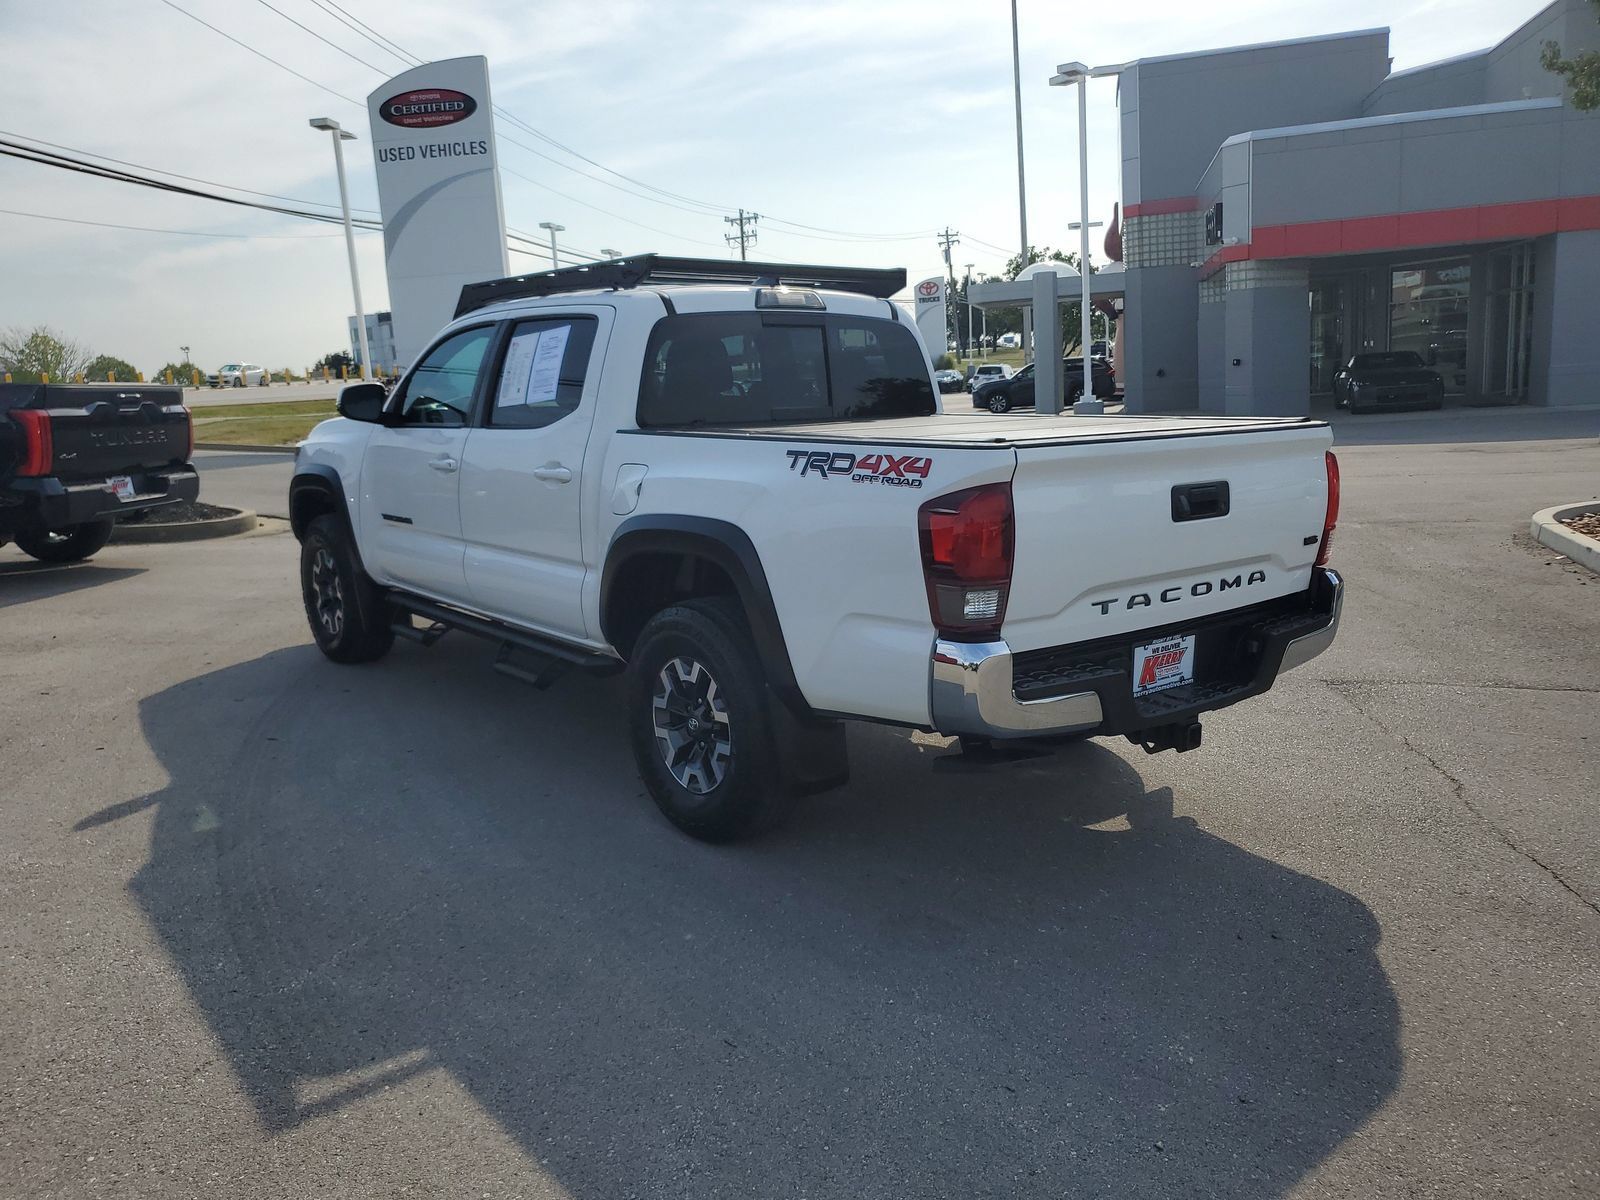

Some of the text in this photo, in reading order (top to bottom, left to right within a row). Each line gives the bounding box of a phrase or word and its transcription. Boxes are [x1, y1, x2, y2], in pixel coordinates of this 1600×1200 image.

[391, 101, 464, 115] CERTIFIED
[379, 141, 488, 162] USED VEHICLES
[786, 450, 857, 480] TRD
[852, 474, 923, 488] OFF ROAD
[1091, 570, 1266, 615] TACOMA
[1151, 642, 1181, 655] WE DELIVER
[1138, 649, 1186, 687] KERRY
